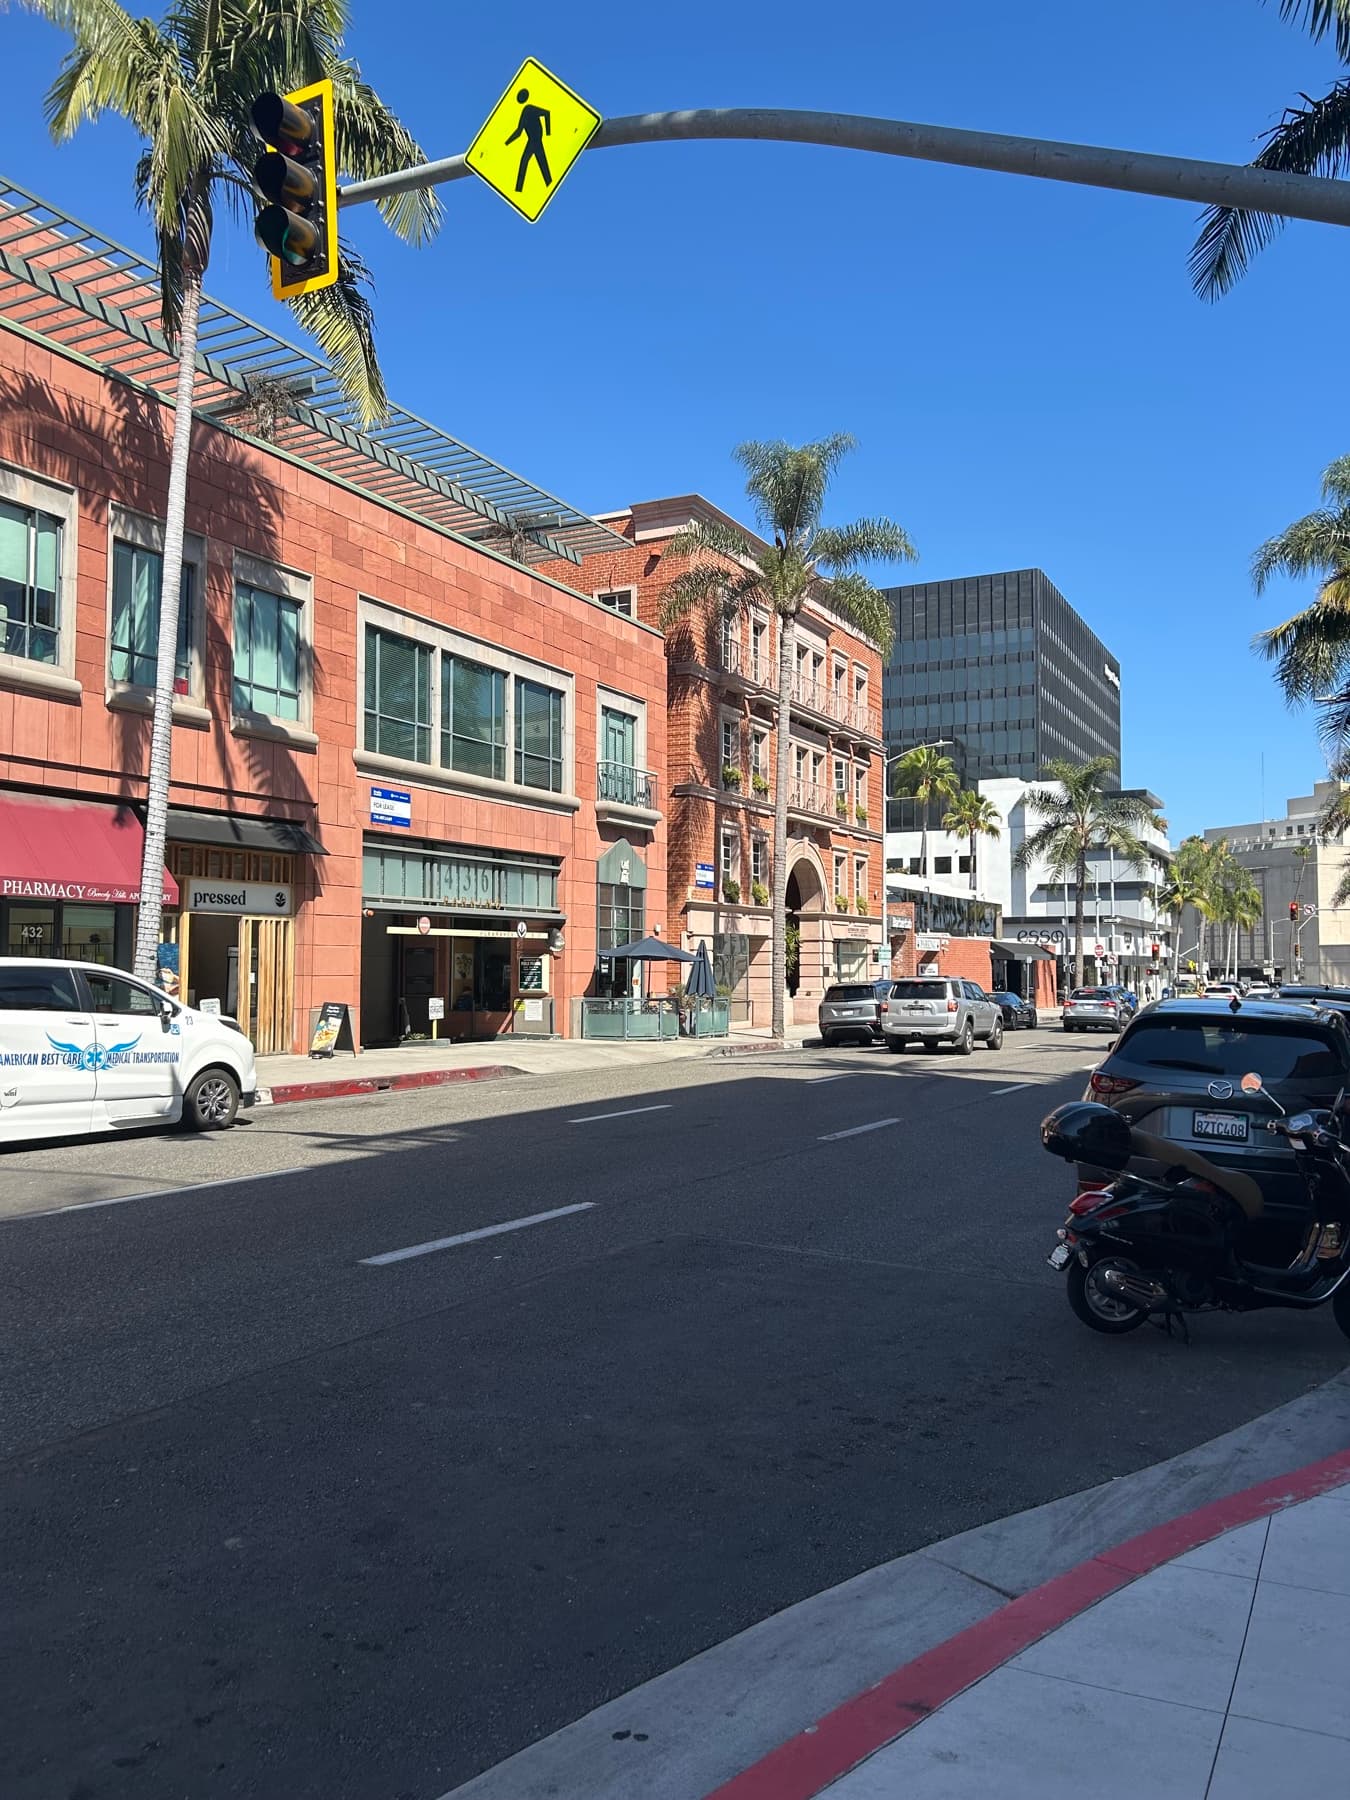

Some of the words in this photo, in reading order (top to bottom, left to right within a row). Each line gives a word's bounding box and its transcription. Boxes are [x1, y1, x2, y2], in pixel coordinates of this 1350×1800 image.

[444, 863, 489, 893] 436
[3, 879, 87, 899] PHARMACY
[193, 889, 247, 908] pressed
[21, 926, 44, 938] 432
[0, 1053, 38, 1066] AMERICAN
[41, 1053, 60, 1066] BEST
[62, 1053, 82, 1065] CARE
[106, 1052, 131, 1064] MEDICAL
[132, 1051, 179, 1064] TRANSPORTATION
[1196, 1120, 1245, 1137] 8ZTC408
